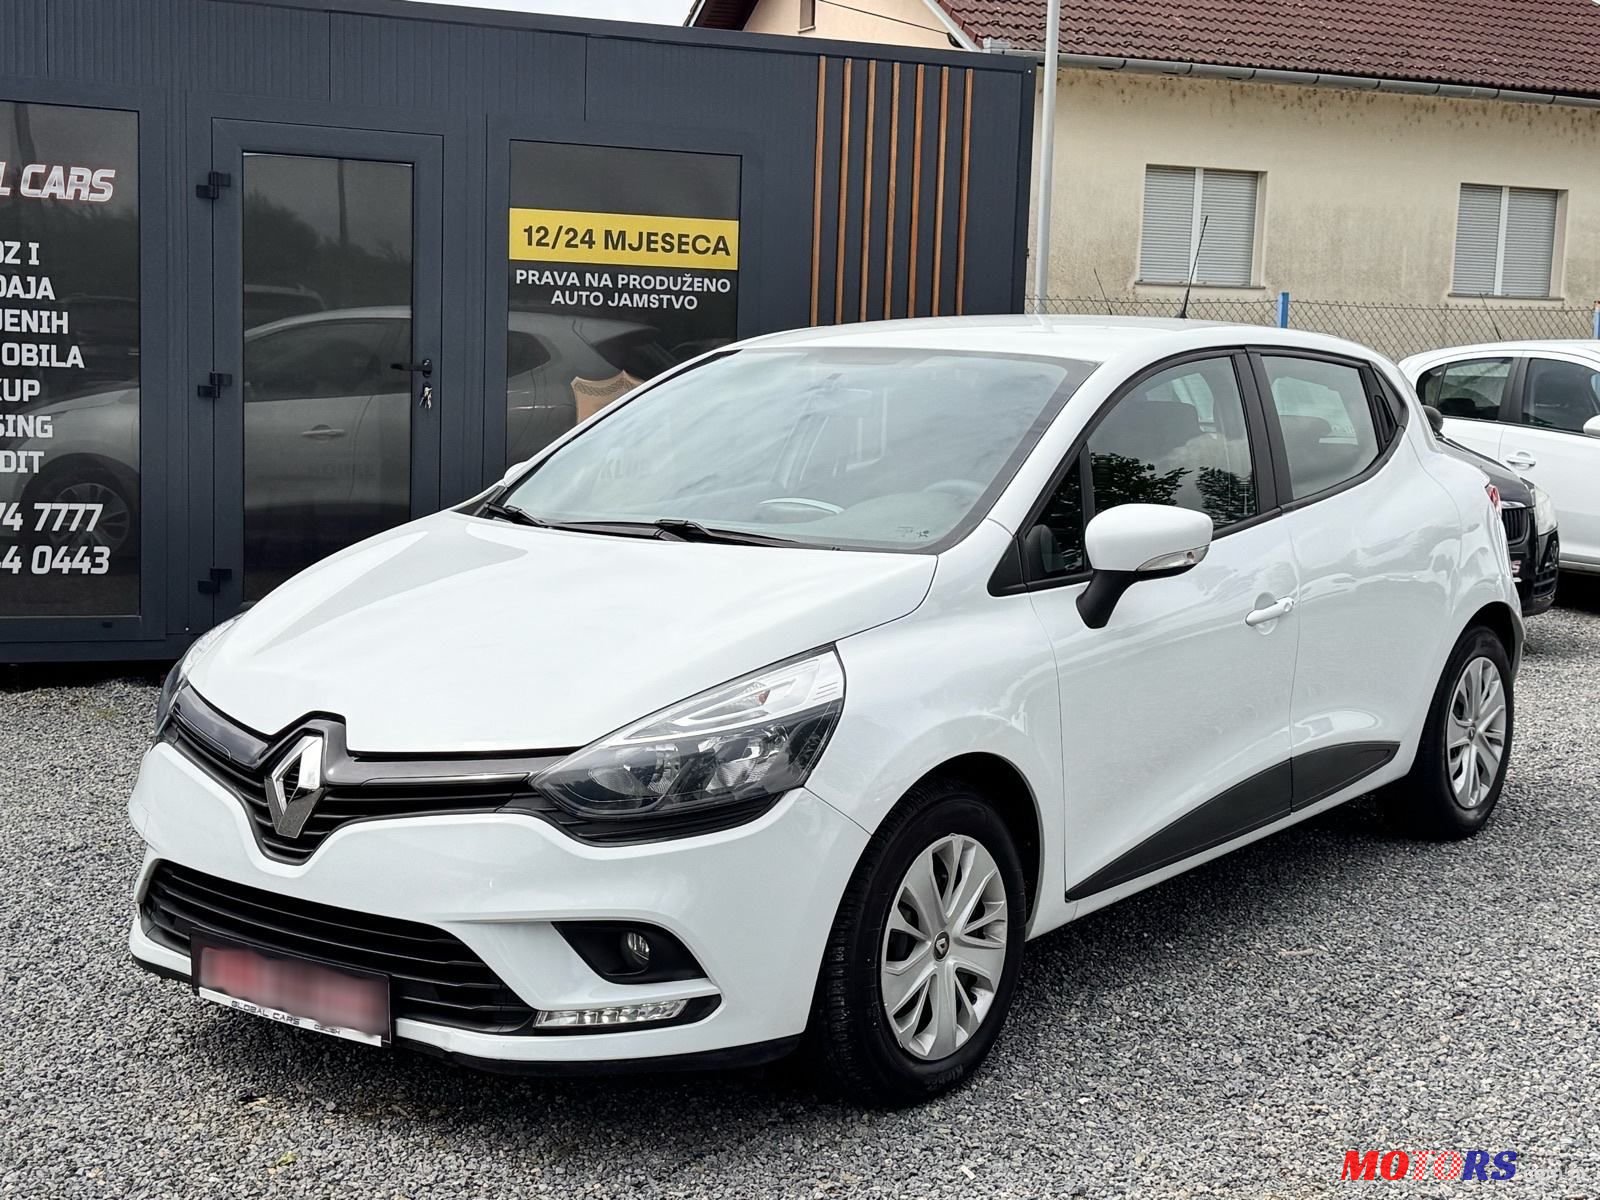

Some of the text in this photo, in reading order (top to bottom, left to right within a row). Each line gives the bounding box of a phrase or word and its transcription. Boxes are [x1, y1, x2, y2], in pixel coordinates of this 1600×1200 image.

[20, 164, 115, 202] CARS
[0, 240, 40, 266] Z I
[523, 225, 731, 257] 12/24 MJESECA
[515, 269, 731, 293] PRAVA NA PRODUŽENO
[551, 291, 698, 310] AUTO JAMSTVO
[0, 308, 69, 335] ENIH
[1, 342, 85, 369] OBILA
[0, 378, 41, 402] UP
[0, 450, 45, 474] DIT
[33, 503, 104, 532] 7777
[0, 545, 111, 575] 4 0443
[231, 1000, 268, 1017] GLOBAL
[272, 1012, 300, 1025] CARS
